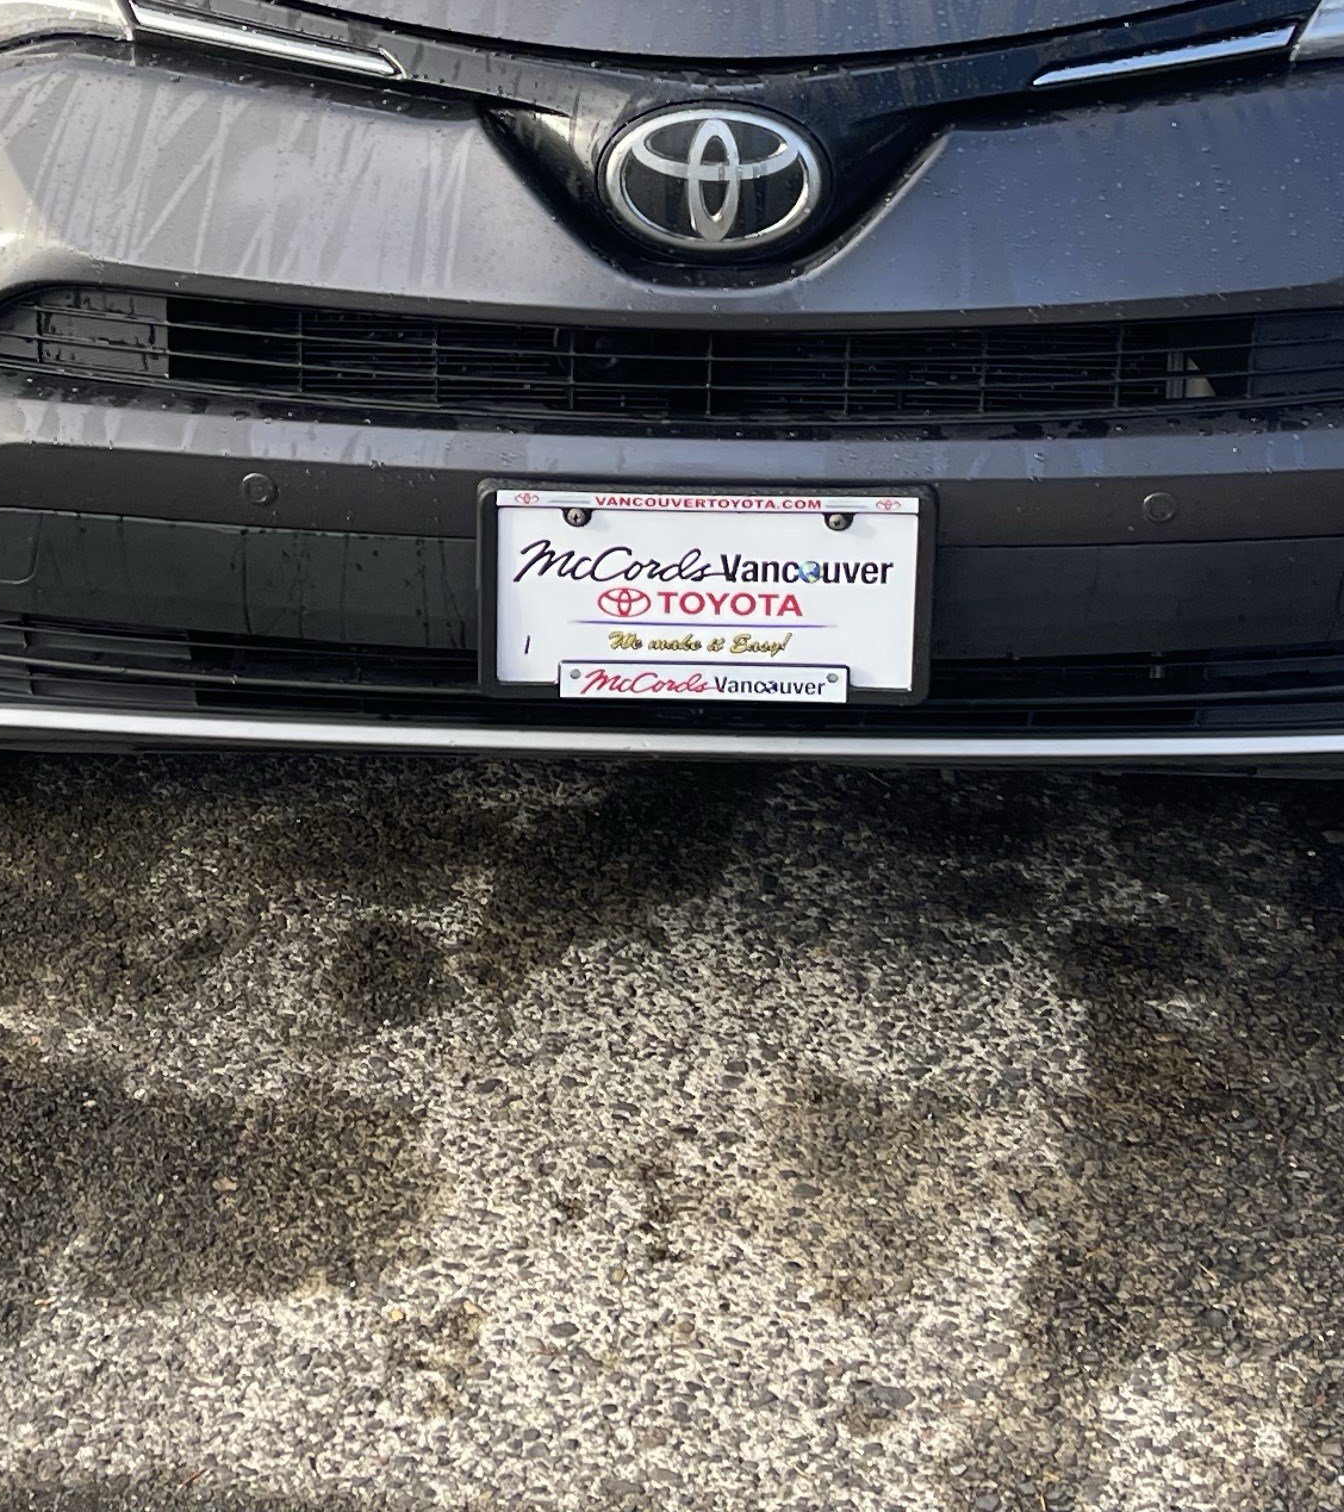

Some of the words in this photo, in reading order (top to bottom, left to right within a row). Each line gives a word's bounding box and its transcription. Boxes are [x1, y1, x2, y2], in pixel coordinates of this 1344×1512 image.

[594, 495, 823, 510] VANCOUVERTOYOTA.COM
[658, 591, 803, 618] TOYOTA
[608, 630, 644, 651] We
[648, 633, 703, 653] make
[707, 637, 727, 653] it
[729, 631, 793, 659] Easy!
